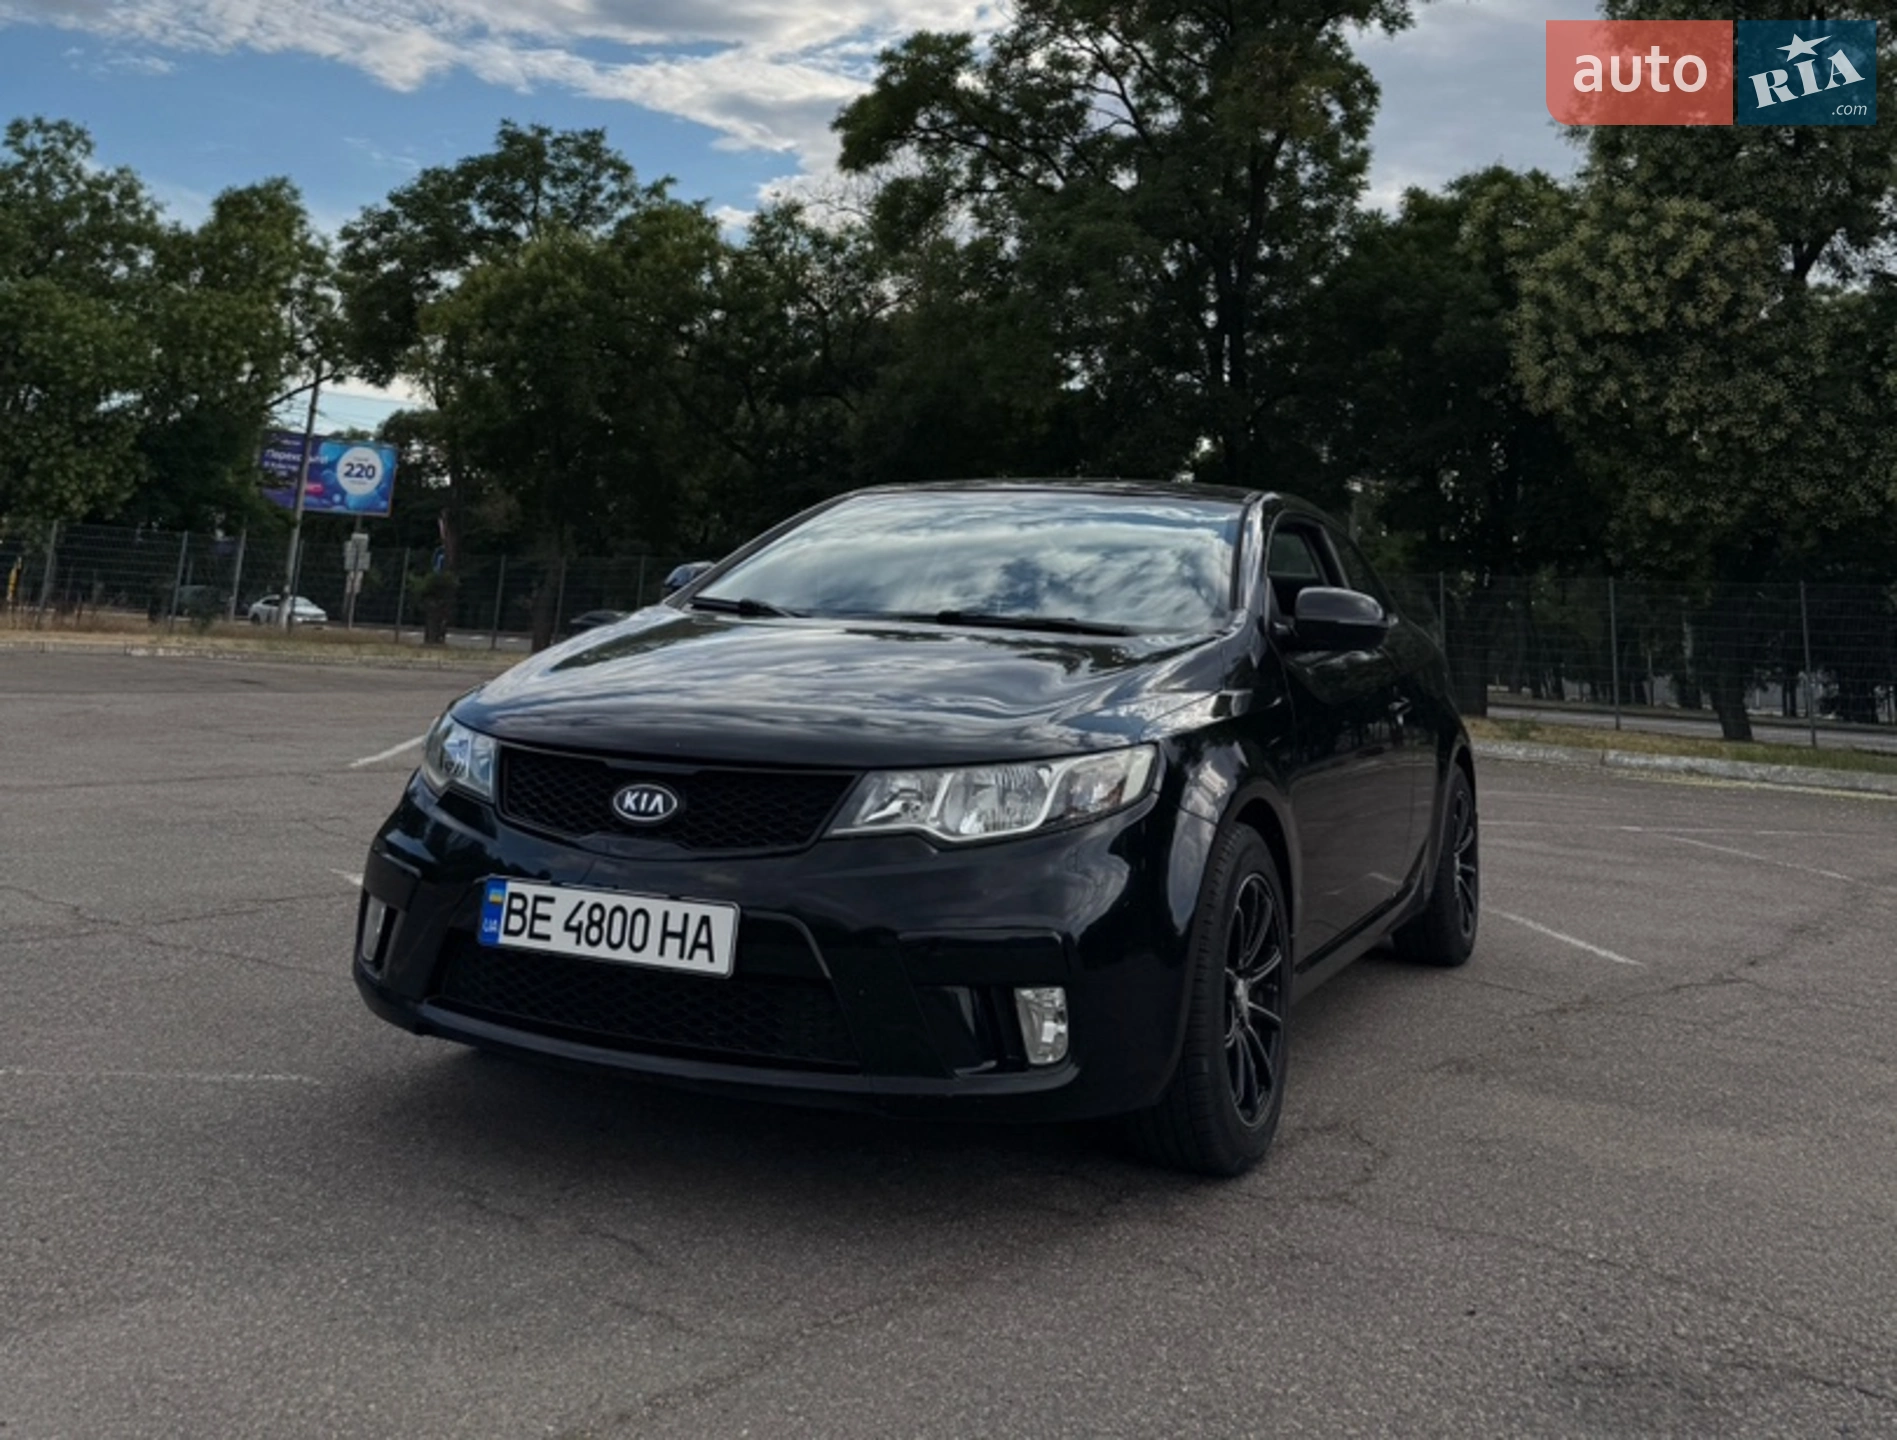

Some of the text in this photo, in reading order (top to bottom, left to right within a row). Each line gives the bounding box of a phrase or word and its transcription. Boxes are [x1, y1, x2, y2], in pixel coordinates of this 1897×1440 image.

[343, 461, 377, 482] 220
[623, 790, 665, 814] KIA
[502, 891, 715, 963] BE 4800 HA
